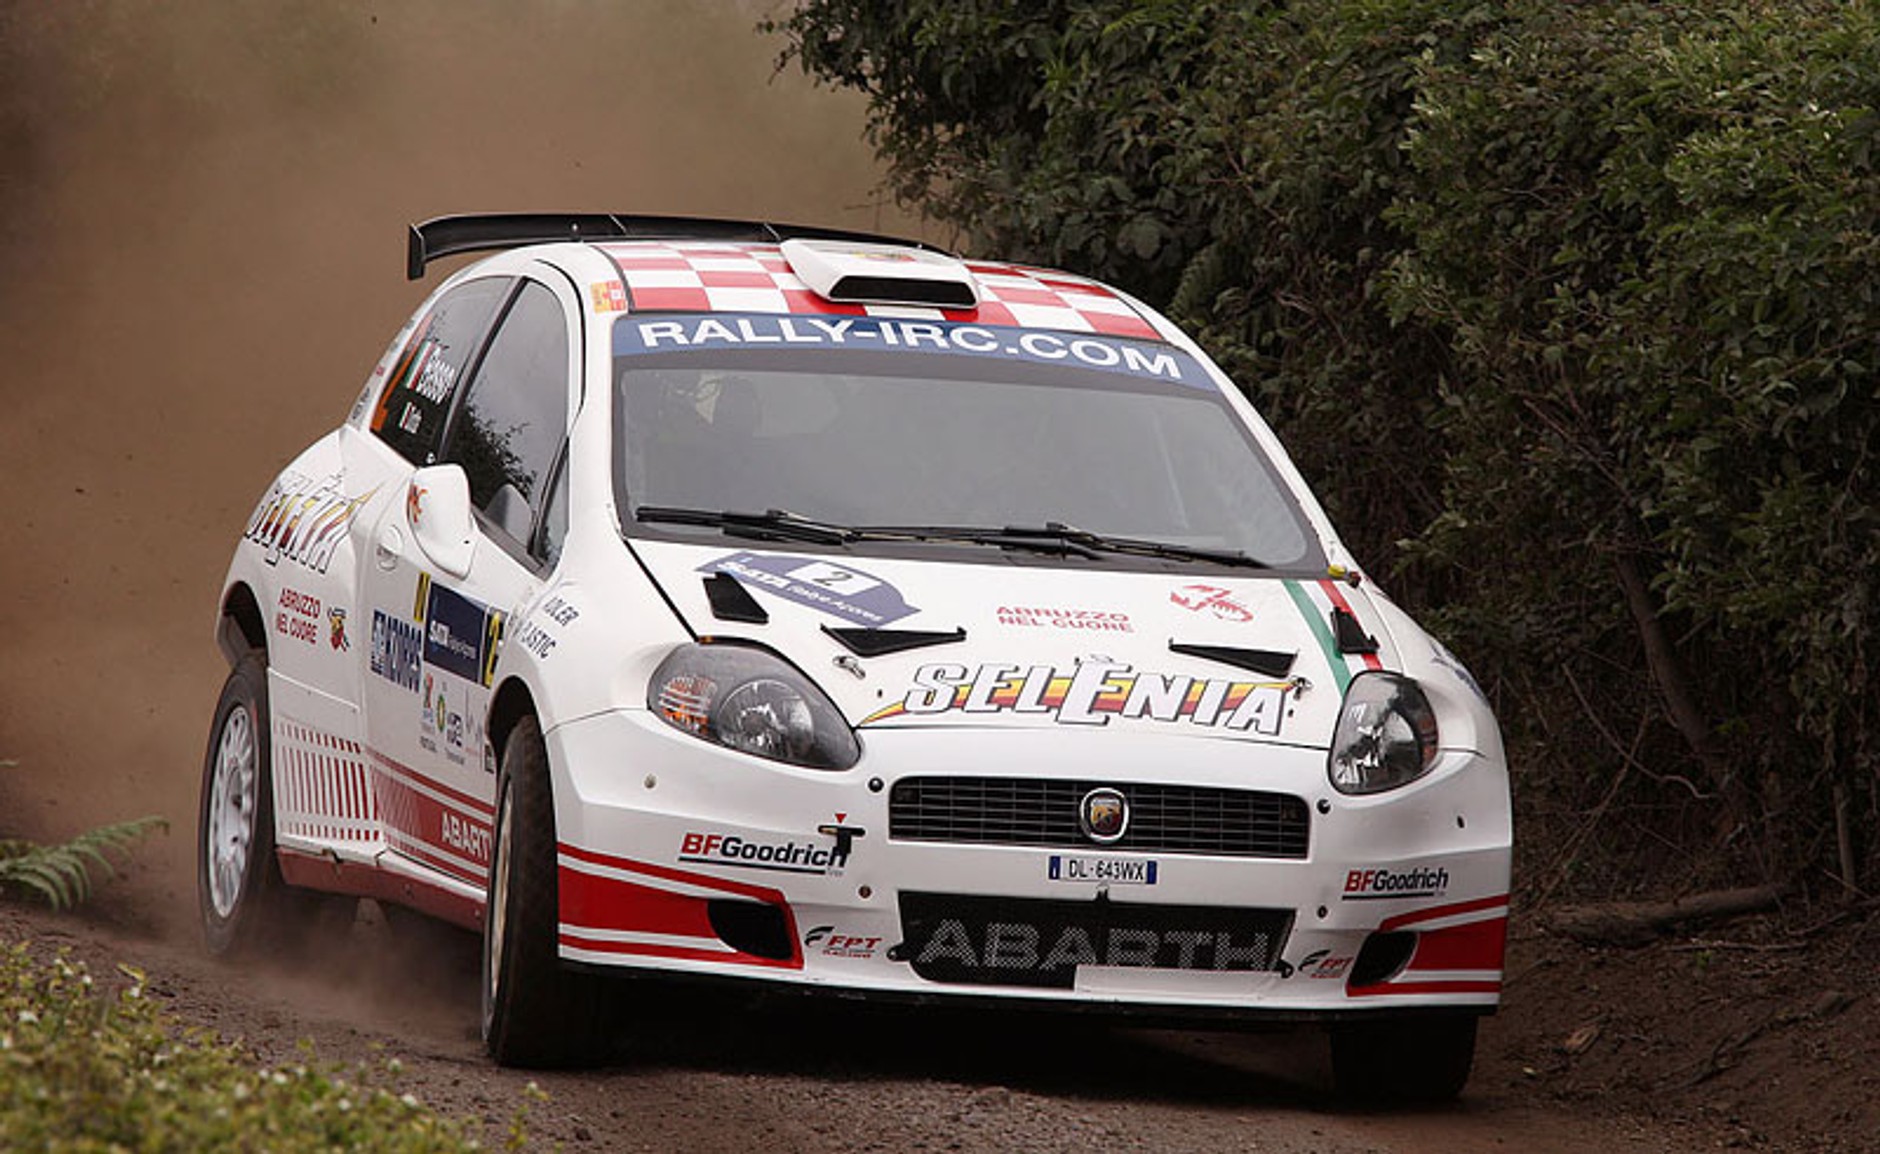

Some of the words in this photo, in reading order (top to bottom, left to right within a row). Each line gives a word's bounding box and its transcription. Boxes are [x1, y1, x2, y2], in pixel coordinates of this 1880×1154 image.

[638, 319, 1182, 379] RALLY-IRC.COM
[813, 571, 853, 586] 2
[278, 588, 321, 619] ABRUZZO
[996, 606, 1129, 622] ABRUZZO
[998, 616, 1025, 627] NEL
[1051, 617, 1135, 634] CUORE
[681, 833, 848, 869] BFGoodrich
[1343, 867, 1450, 893] BFGoodrich
[827, 935, 882, 949] FPT
[918, 918, 1271, 971] ABARTH
